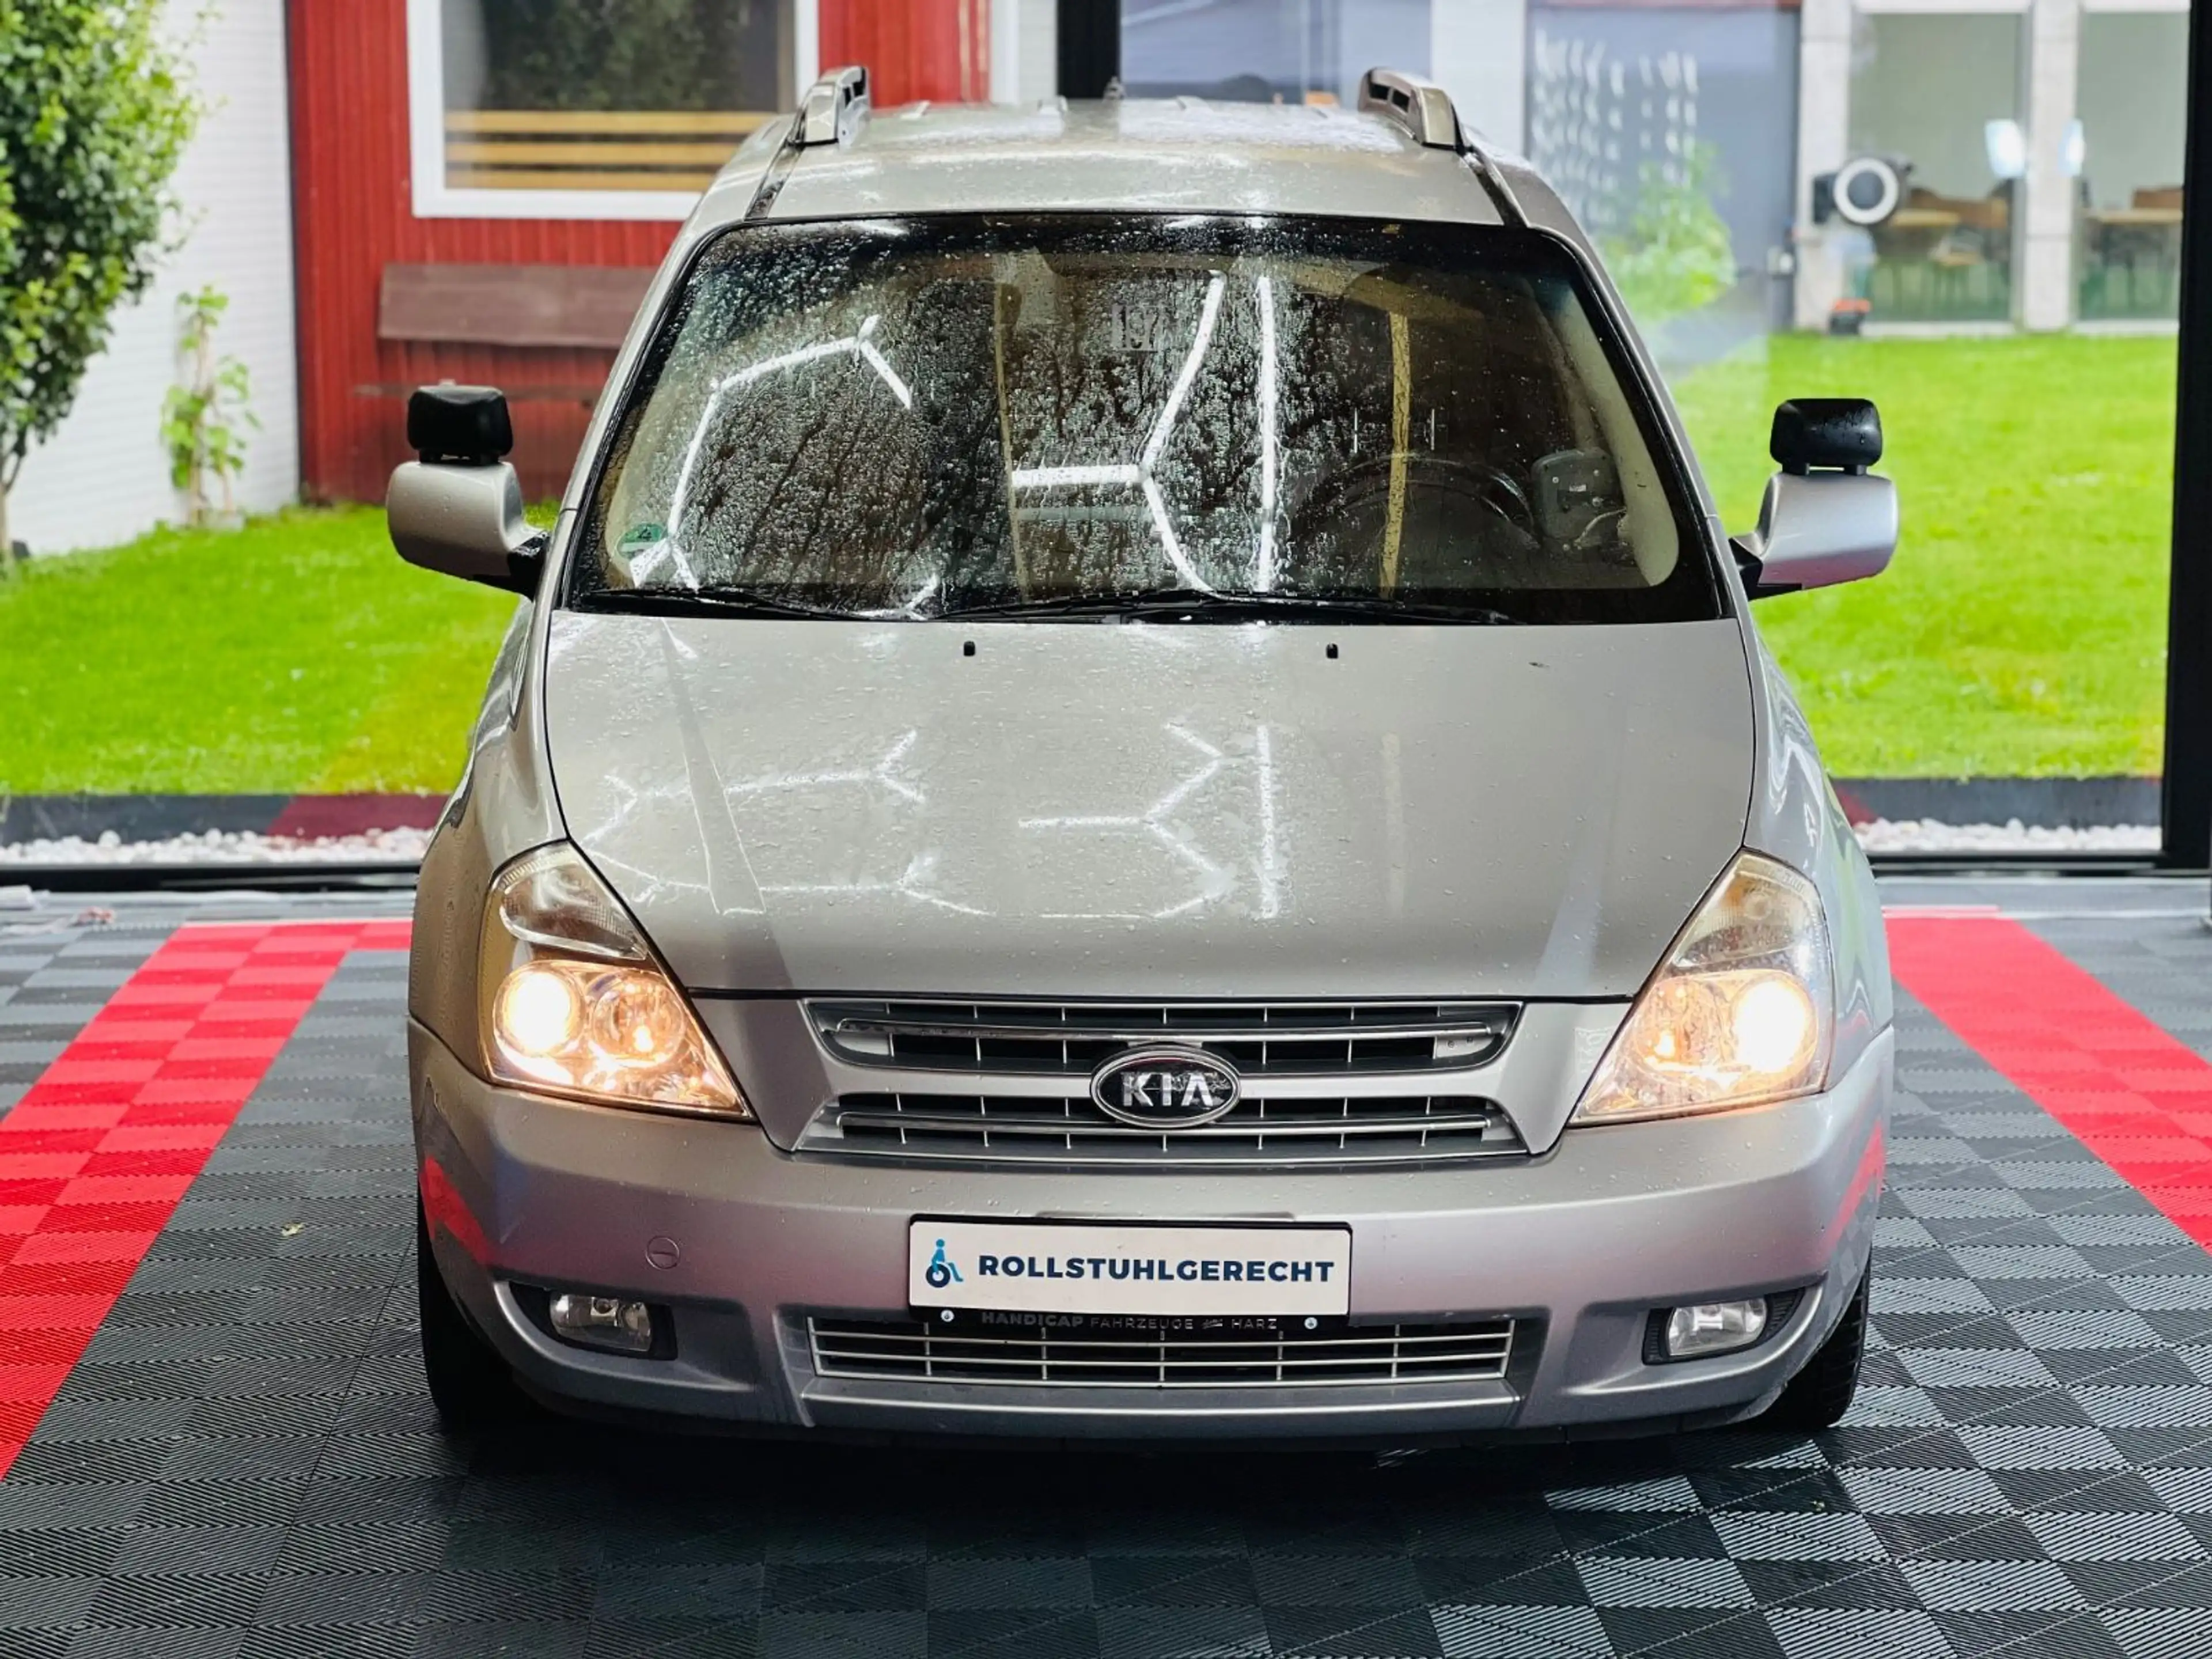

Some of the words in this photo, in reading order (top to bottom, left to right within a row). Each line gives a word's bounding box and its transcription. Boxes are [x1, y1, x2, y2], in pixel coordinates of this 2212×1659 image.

[1121, 1071, 1214, 1107] KIA
[979, 1255, 1334, 1282] ROLLSTUHLGERECHT
[981, 1311, 1084, 1327] HANDICAP
[1090, 1316, 1194, 1330] FAHRZEUGE
[1231, 1318, 1277, 1330] HARZ
